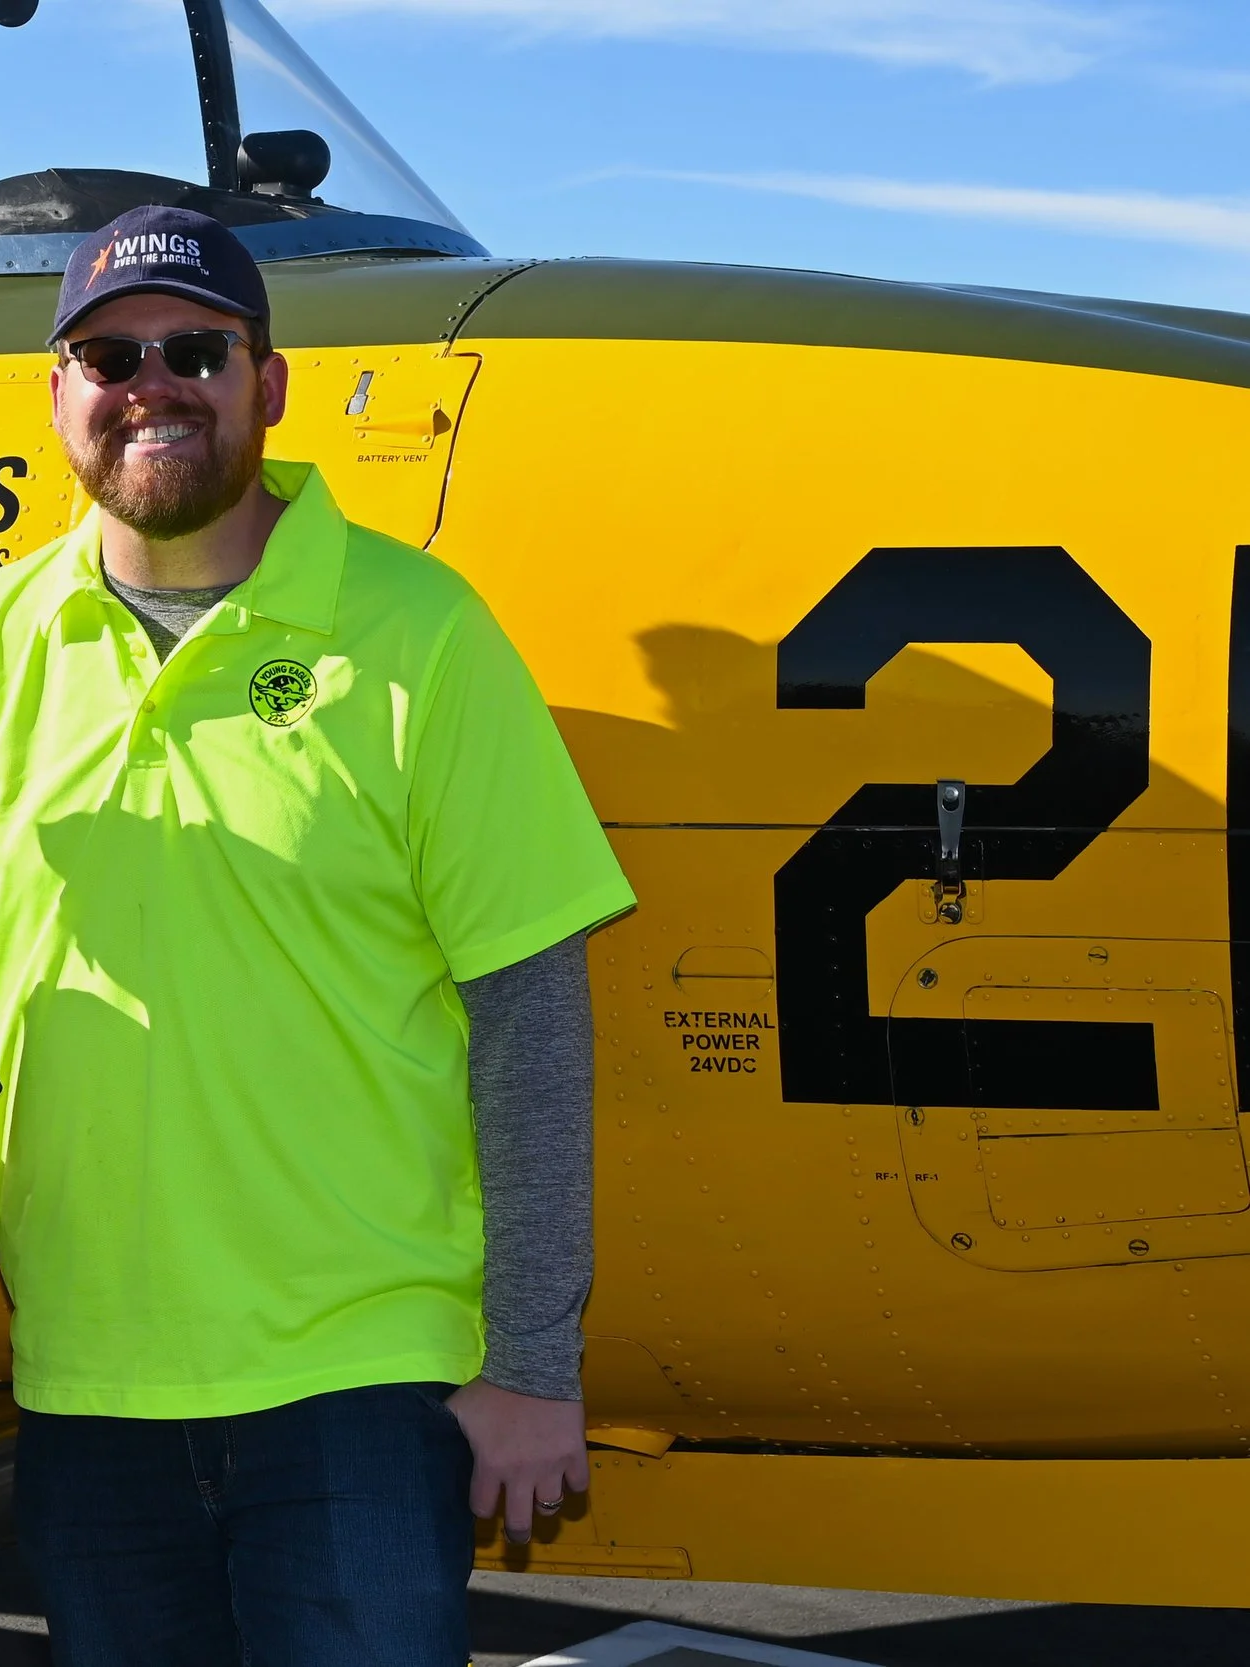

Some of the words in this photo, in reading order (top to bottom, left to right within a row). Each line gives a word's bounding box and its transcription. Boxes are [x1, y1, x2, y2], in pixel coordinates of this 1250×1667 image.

[114, 232, 200, 258] WINGS
[113, 254, 137, 269] OVER
[142, 253, 158, 264] THE
[161, 254, 201, 267] ROCKIES
[357, 454, 401, 462] BATTERY
[403, 454, 429, 462] VENT
[260, 665, 287, 681] YOUNG
[289, 666, 311, 689] EAGLES
[774, 545, 1250, 1112] 2
[664, 1011, 775, 1029] EXTERNAL
[682, 1034, 760, 1050] POWER
[690, 1056, 757, 1073] 24VDC
[875, 1172, 899, 1181] RF-1
[915, 1173, 939, 1182] RF-1
